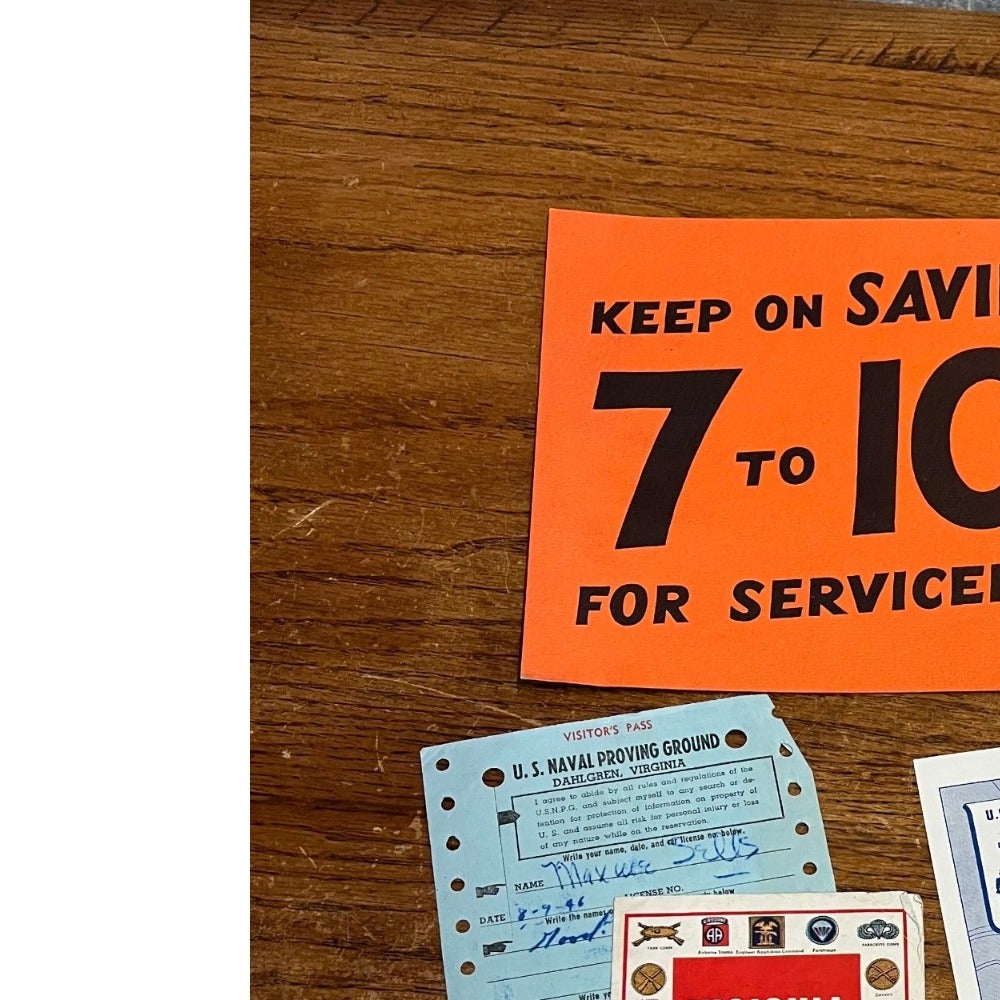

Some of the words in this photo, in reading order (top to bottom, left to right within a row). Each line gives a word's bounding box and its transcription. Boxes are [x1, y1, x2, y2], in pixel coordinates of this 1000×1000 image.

[591, 296, 731, 335] KEEP
[754, 293, 823, 330] ON
[593, 368, 740, 551] 7
[736, 447, 816, 487] TO
[575, 583, 688, 626] FOR
[564, 725, 618, 741] VISITOR'S
[626, 720, 653, 732] PASS
[513, 764, 528, 779] U.
[532, 761, 544, 777] S.
[548, 753, 594, 774] NAVAL
[597, 743, 659, 766] PROVING
[663, 733, 720, 756] GROUND
[553, 769, 623, 787] DAHLGREN,
[630, 759, 686, 775] VIRGINIA
[681, 771, 725, 783] regulations
[603, 797, 631, 806] subject
[636, 791, 662, 800] myself
[699, 782, 725, 790] search
[537, 818, 565, 827] tention
[587, 809, 626, 820] protection
[645, 799, 690, 810] information
[711, 789, 744, 801] property
[583, 822, 613, 831] assume
[666, 807, 701, 819] personal
[704, 803, 727, 813] injury
[563, 852, 582, 862] Write
[586, 848, 602, 859] your
[605, 847, 626, 856] name,
[630, 843, 648, 853] date,
[651, 840, 664, 848] and
[680, 835, 704, 844] license
[573, 835, 599, 843] nature
[515, 880, 544, 891] NAME
[667, 885, 684, 893] NO.
[480, 914, 506, 925] DATE
[545, 917, 566, 925] Write
[569, 914, 581, 923] the
